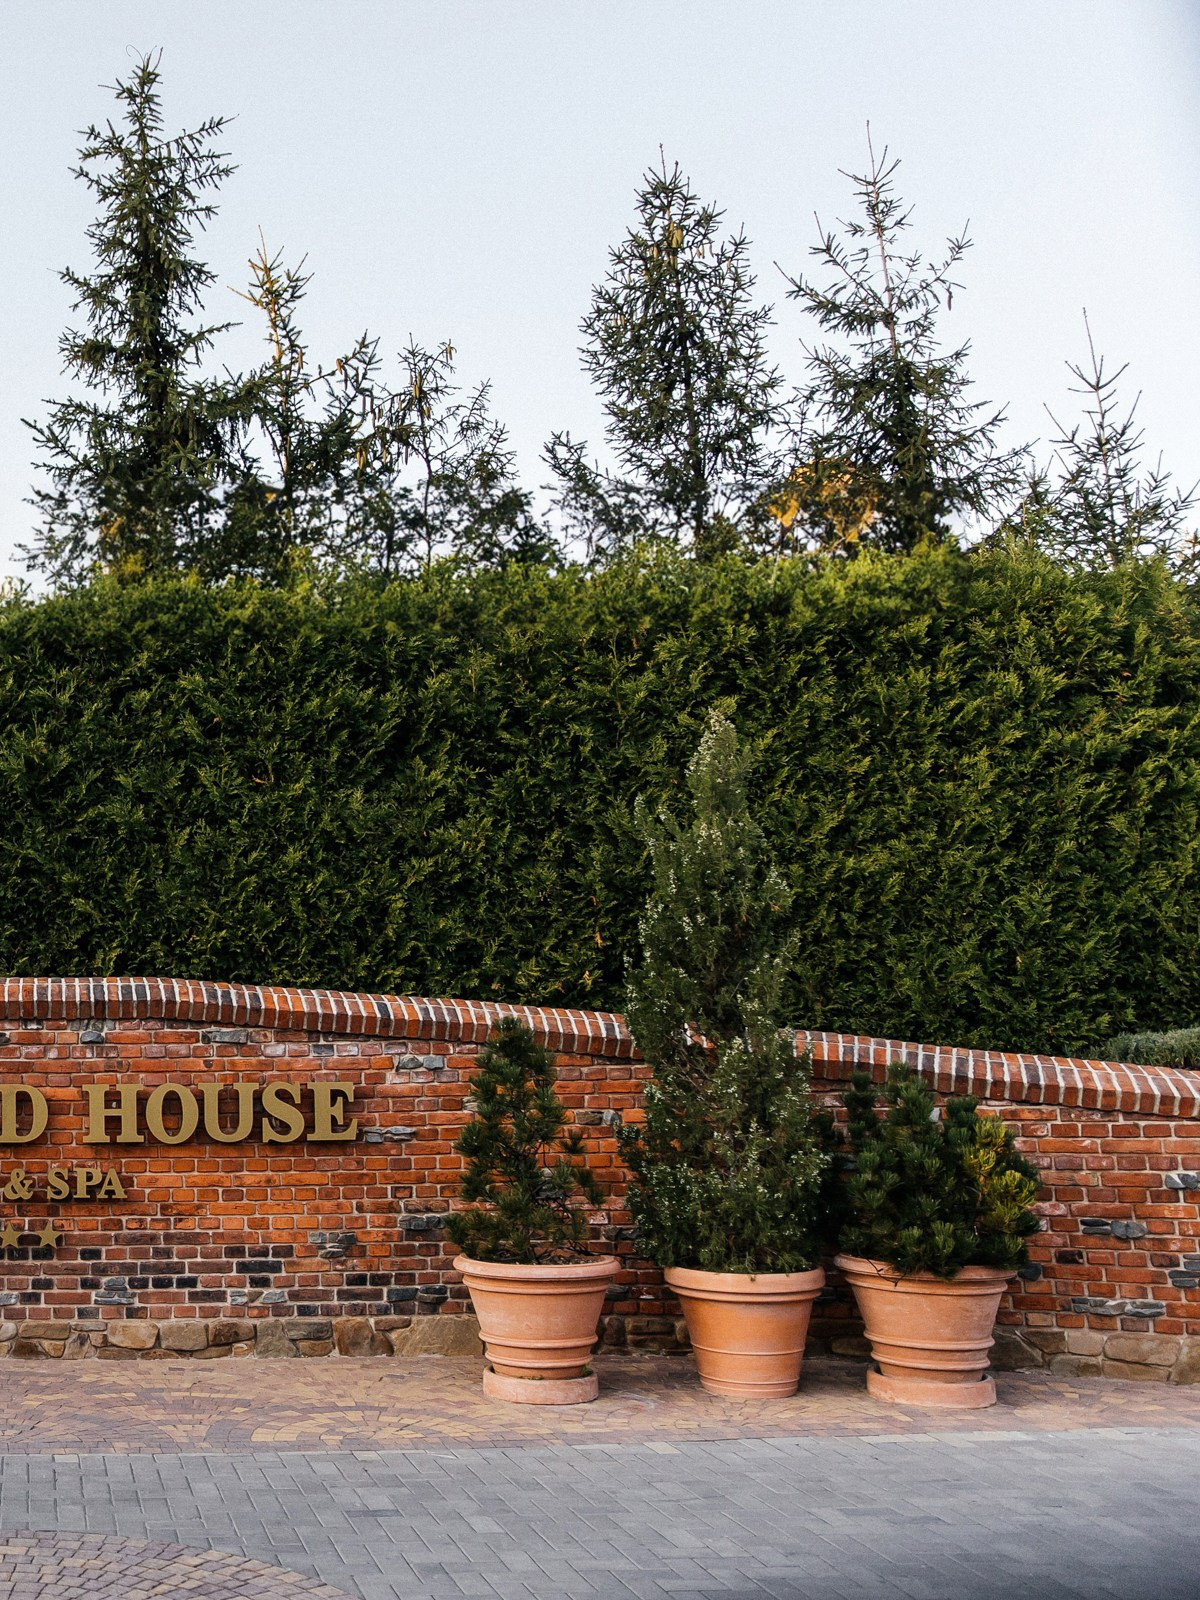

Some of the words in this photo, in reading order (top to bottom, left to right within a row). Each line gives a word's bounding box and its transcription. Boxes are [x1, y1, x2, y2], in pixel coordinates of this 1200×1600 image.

[82, 1081, 359, 1145] HOUSE
[3, 1167, 34, 1200] &
[46, 1167, 128, 1200] SPA
